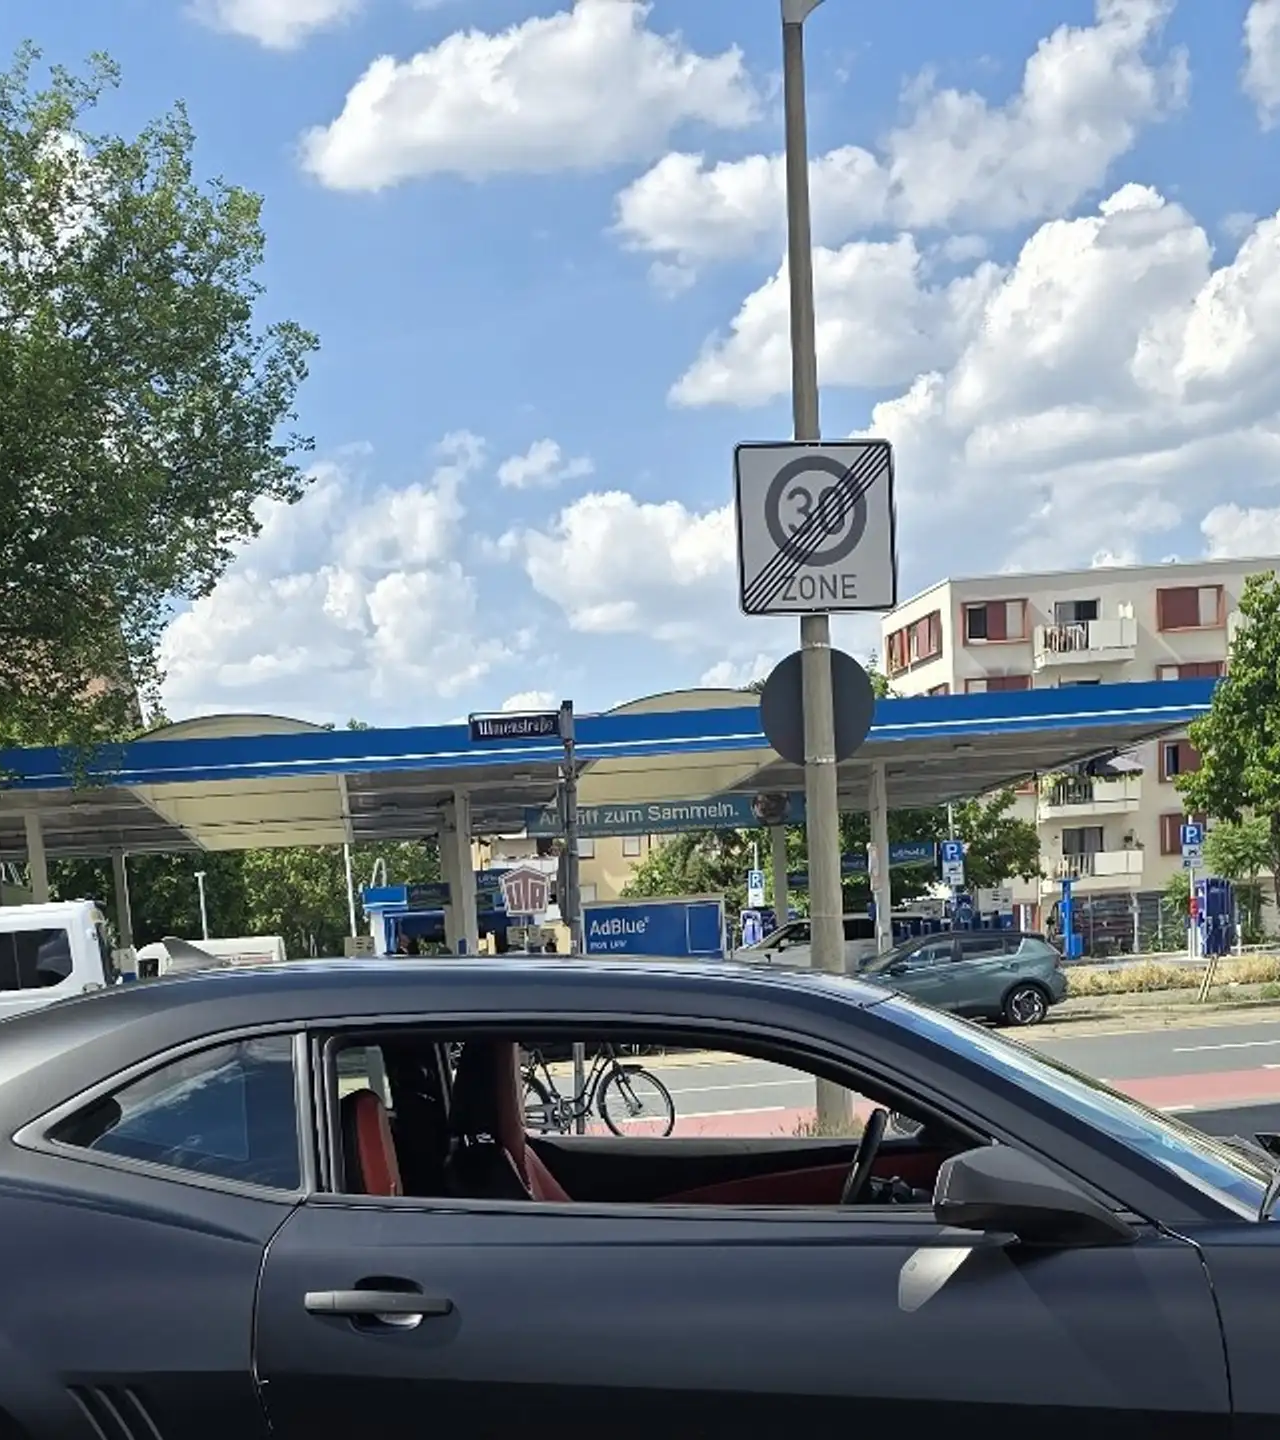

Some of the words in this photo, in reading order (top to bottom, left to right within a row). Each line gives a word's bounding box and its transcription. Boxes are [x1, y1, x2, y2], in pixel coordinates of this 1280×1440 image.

[786, 486, 846, 535] 30
[782, 574, 857, 601] ZONE
[604, 809, 643, 824] zum
[648, 802, 739, 822] Sammeln.
